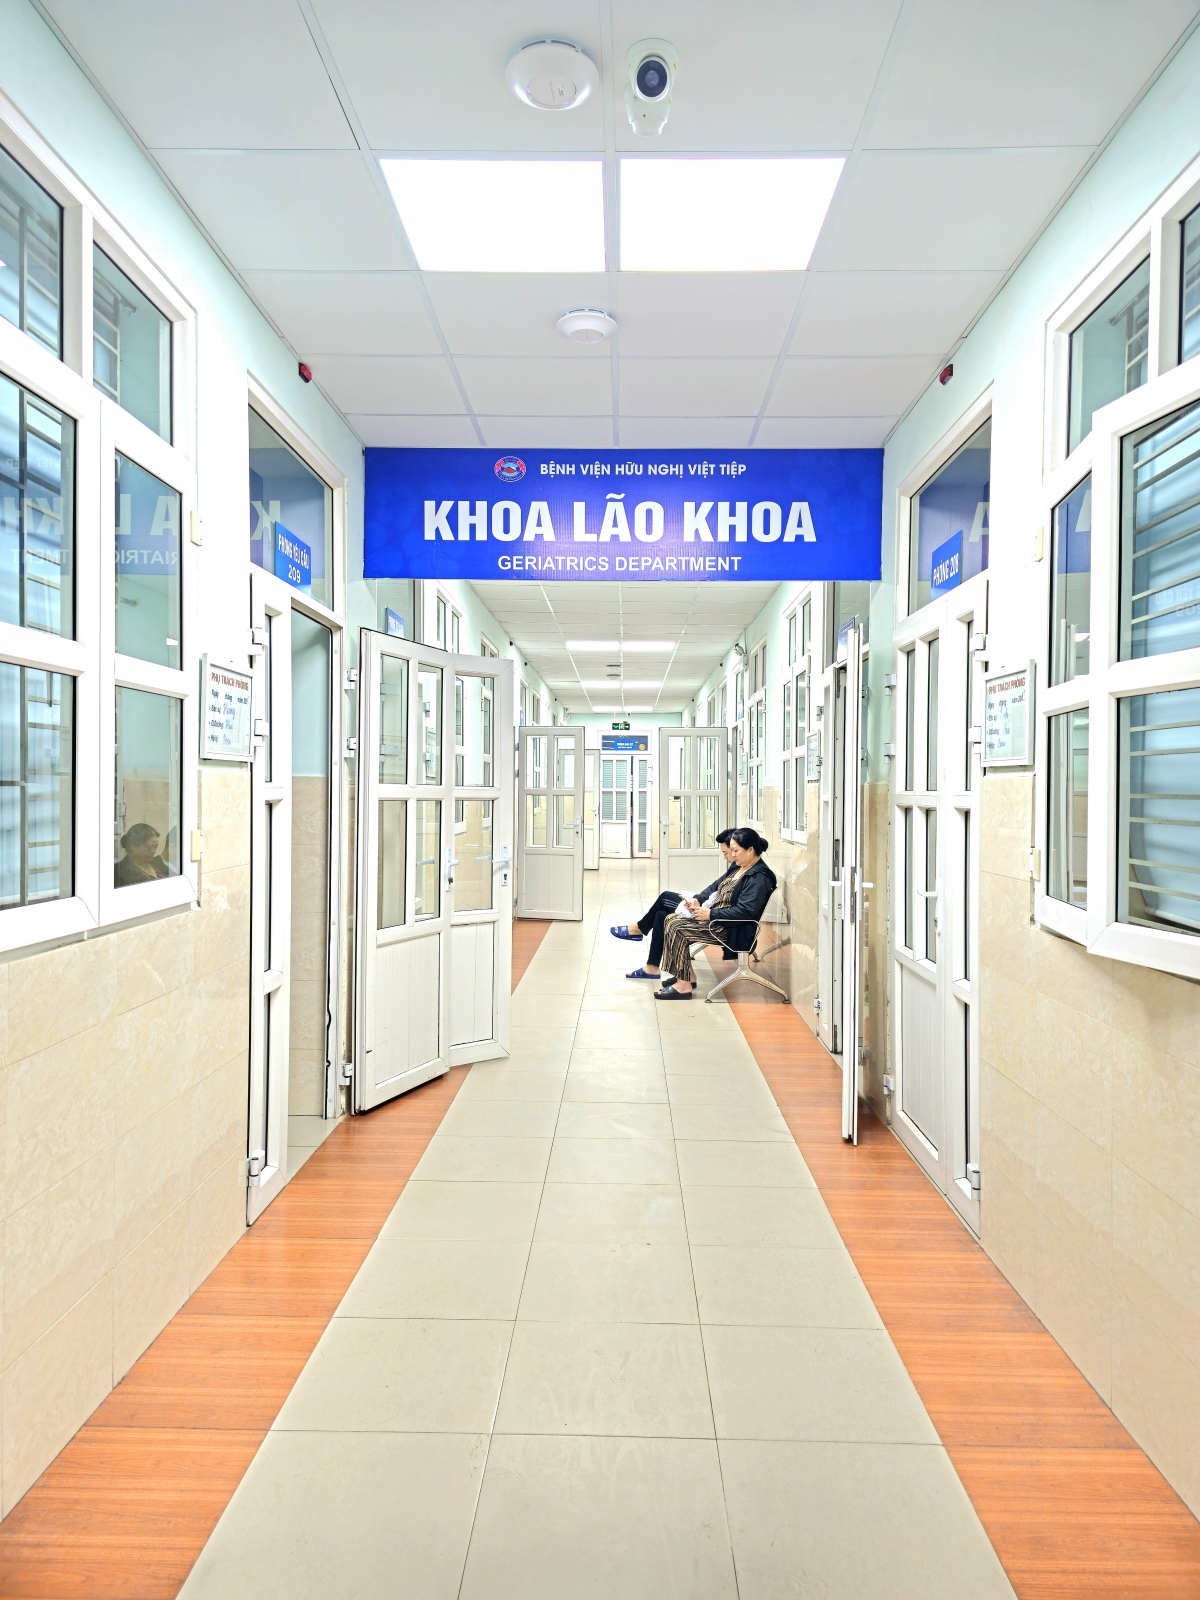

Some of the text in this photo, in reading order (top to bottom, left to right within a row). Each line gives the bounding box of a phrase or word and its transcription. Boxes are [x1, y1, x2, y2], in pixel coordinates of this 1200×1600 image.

[540, 460, 747, 479] BỆNH VIỆN HỮU NGHỊ VIỆT TIỆP
[424, 493, 817, 543] KHOA LÃO KHOA
[278, 533, 293, 559] PHÒNG
[497, 555, 742, 572] GERIATRICS DEPARTMENT
[288, 564, 301, 584] 209
[932, 558, 949, 589] PHÒNG
[211, 672, 221, 686] PHỤ
[1010, 676, 1026, 689] PHÒNG
